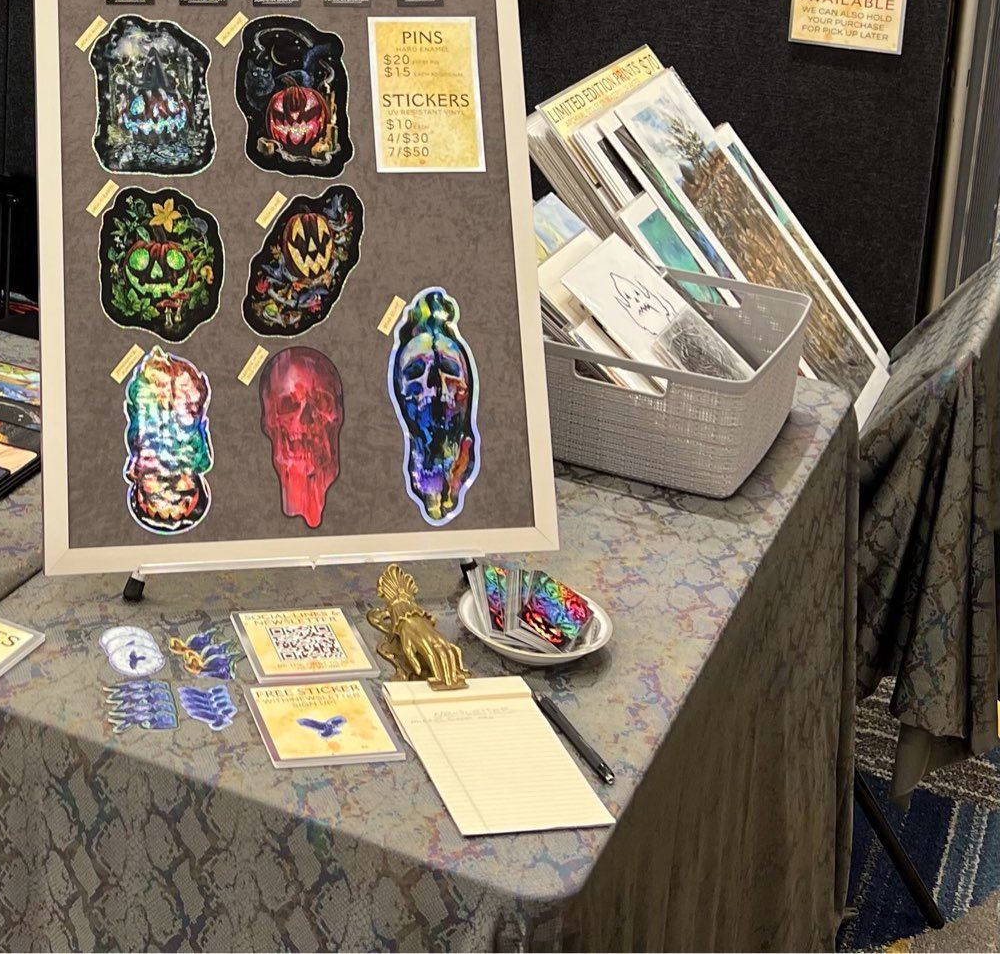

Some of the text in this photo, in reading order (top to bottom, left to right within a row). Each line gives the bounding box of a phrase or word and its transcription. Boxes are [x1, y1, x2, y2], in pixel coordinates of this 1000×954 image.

[802, 6, 892, 23] WE CAN ALSO HOLD
[808, 16, 885, 31] YOUR PURCHASE
[402, 30, 443, 45] PINS
[802, 24, 888, 42] FOR PICK UP LATER
[384, 54, 410, 66] $20
[384, 66, 411, 78] $15
[547, 94, 586, 124] LIMITED
[582, 76, 615, 103] EDITION
[612, 60, 642, 86] PRINTS
[638, 54, 660, 76] $70
[382, 94, 470, 108] STICKERS
[386, 118, 412, 130] $10
[387, 132, 429, 144] 4/$30
[388, 146, 430, 158] 7/$50
[256, 684, 361, 698] FREE STICKER
